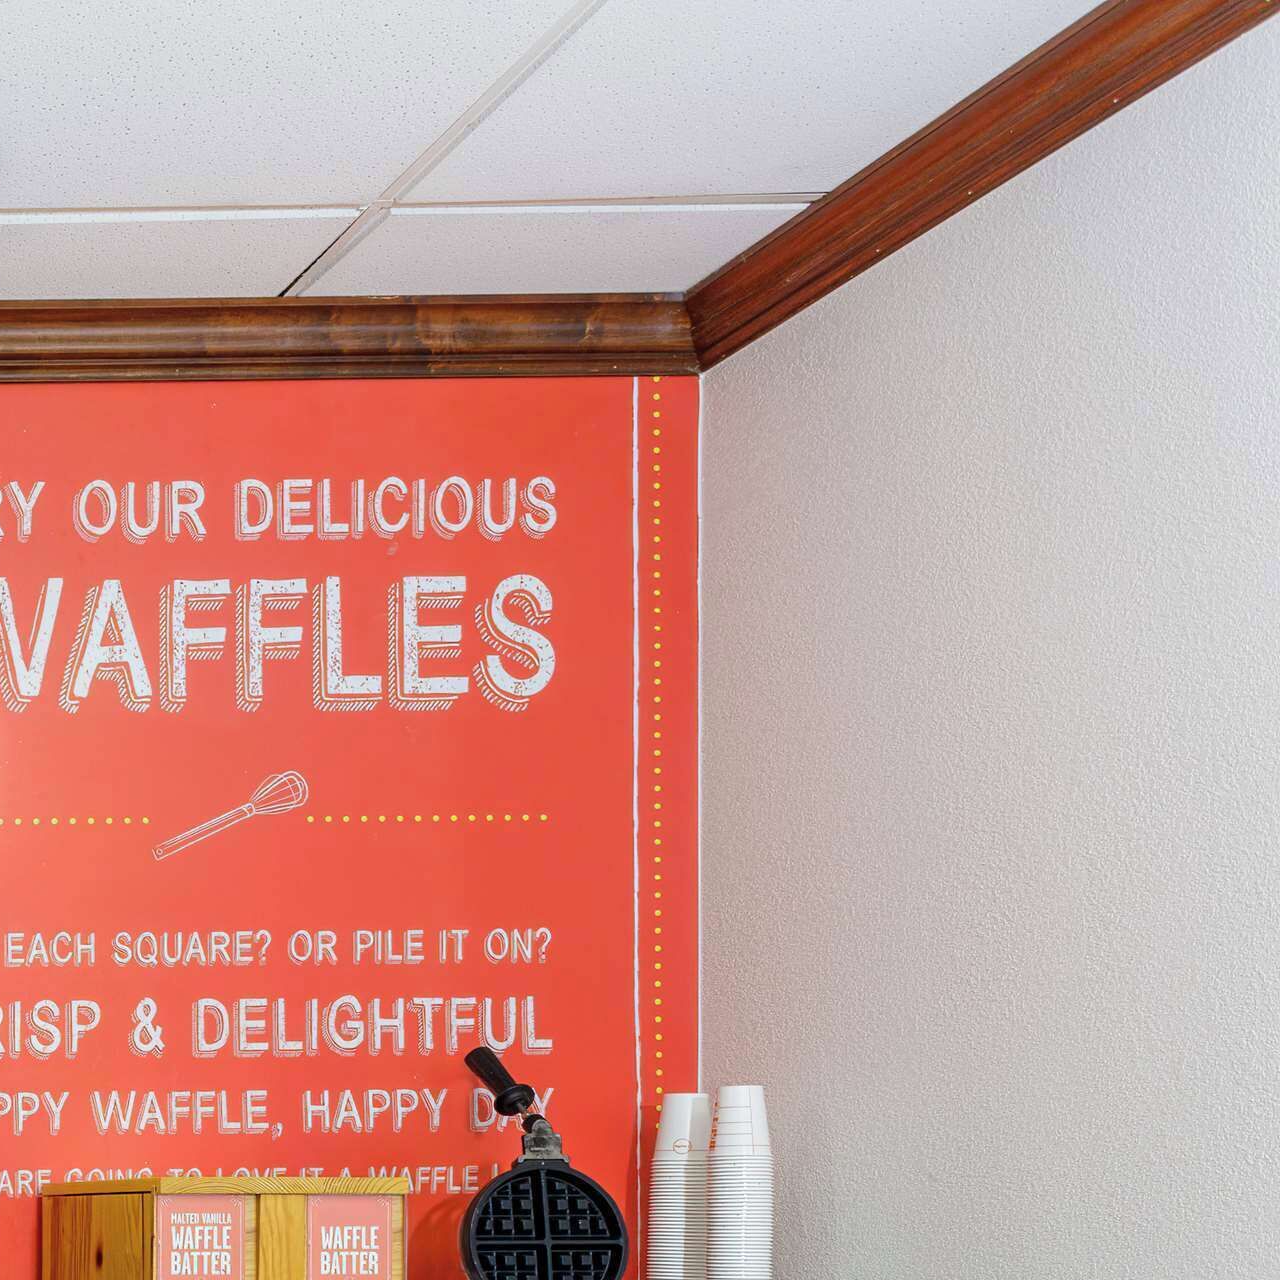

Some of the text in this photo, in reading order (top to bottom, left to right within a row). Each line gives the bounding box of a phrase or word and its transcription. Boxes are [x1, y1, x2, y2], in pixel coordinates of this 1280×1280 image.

[73, 478, 208, 545] OUR
[234, 475, 558, 543] DELICIOUS
[4, 931, 96, 967] EACH
[111, 929, 273, 967] SQUARE?
[288, 929, 338, 966] OR
[352, 928, 425, 965] PILE
[439, 928, 470, 964] IT
[483, 926, 553, 964] ON?
[128, 997, 167, 1058] &
[191, 994, 554, 1059] DELIGHTFUL
[91, 1088, 285, 1140] WAFFLE,
[301, 1087, 448, 1135] HAPPY
[170, 1212, 232, 1225] MALTED VANILLA
[171, 1226, 232, 1250] WAFFLE
[321, 1226, 380, 1250] WAFFLE
[170, 1251, 232, 1276] BATTER
[320, 1251, 379, 1276] BATTER
